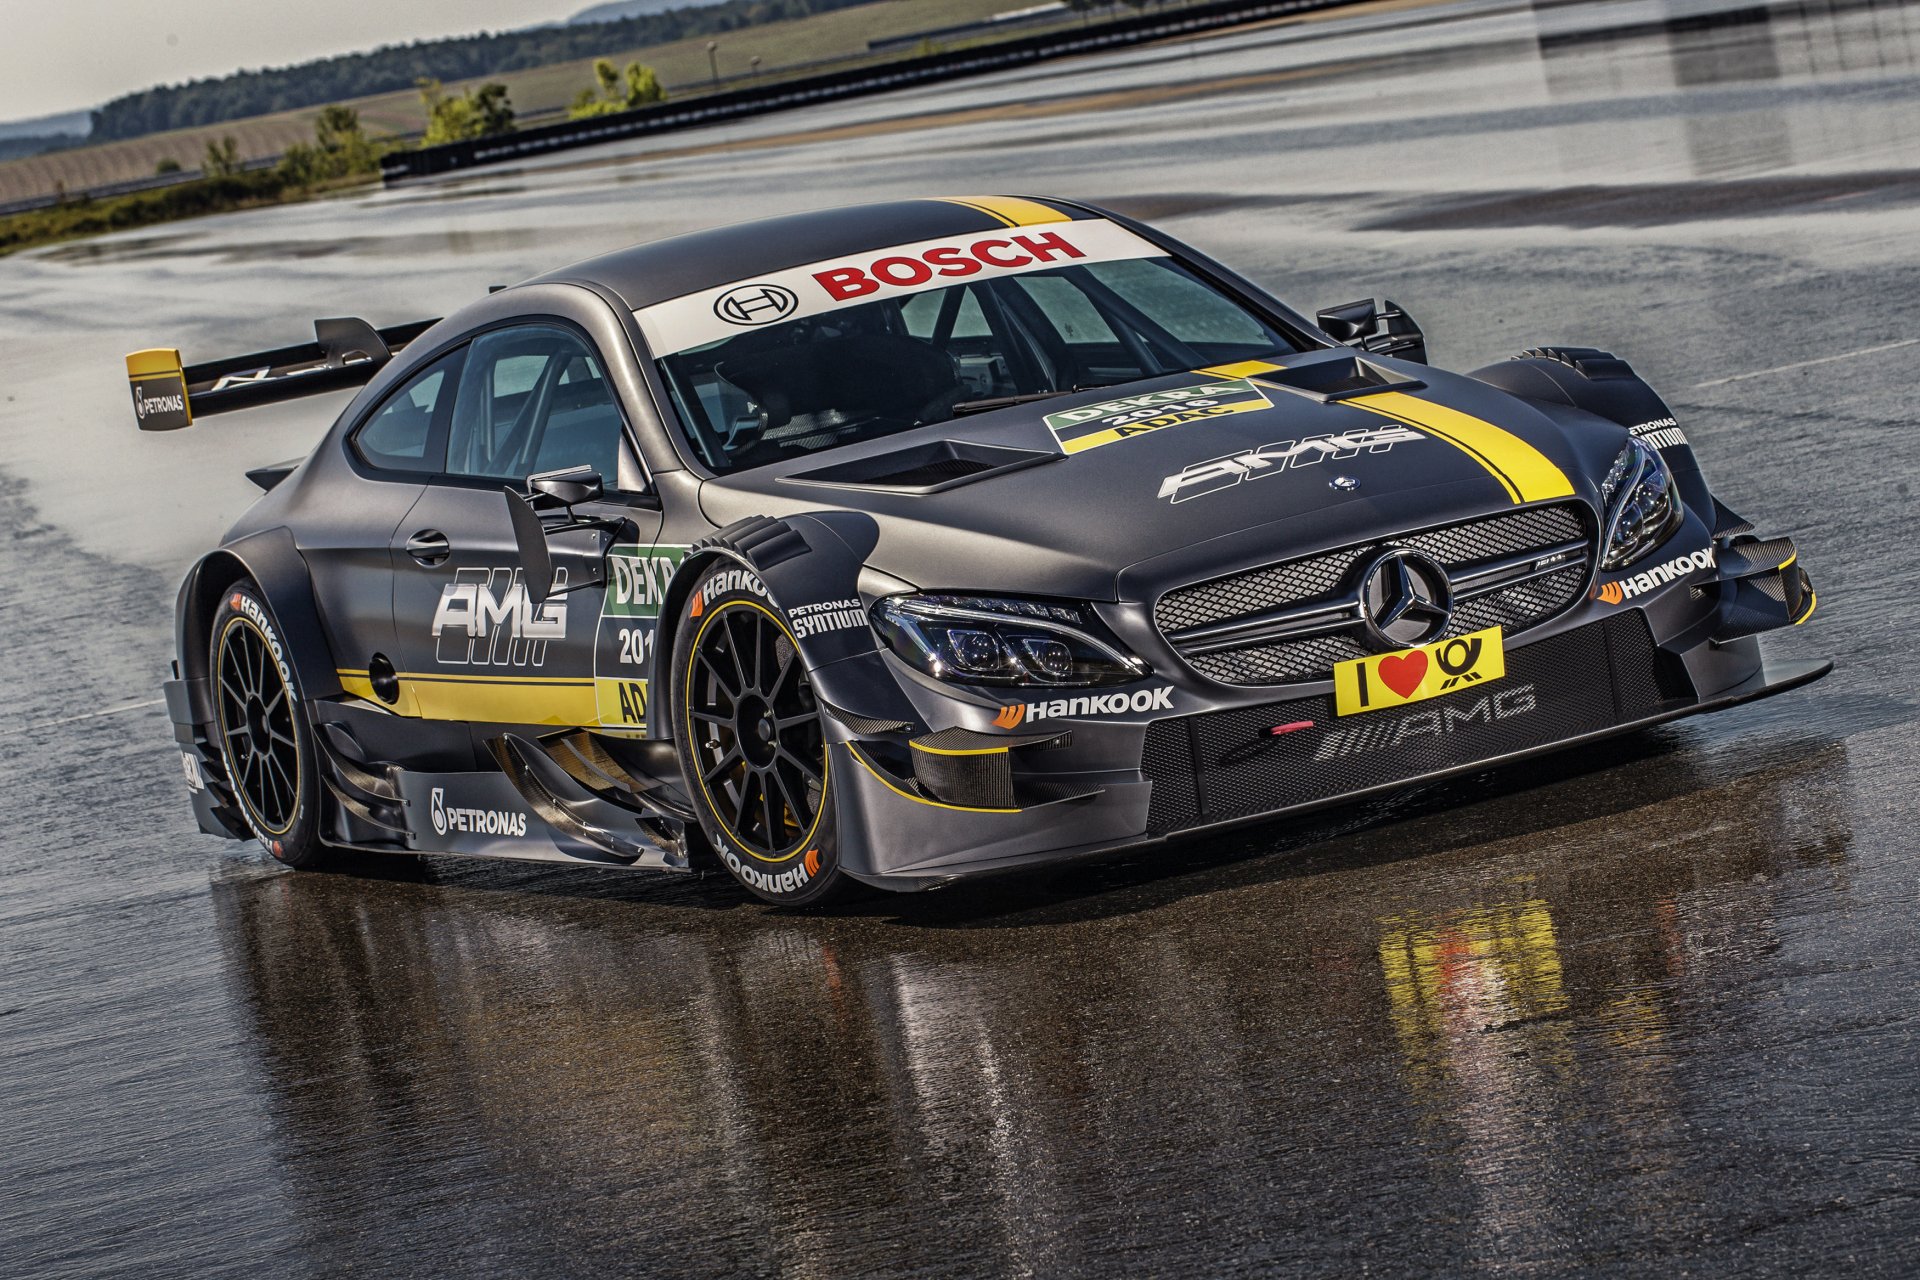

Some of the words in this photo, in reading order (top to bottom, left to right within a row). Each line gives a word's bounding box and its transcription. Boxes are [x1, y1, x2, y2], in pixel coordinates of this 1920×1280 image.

[811, 231, 1086, 302] BOSCH
[144, 395, 184, 415] PETRONAS
[1058, 385, 1242, 422] DEKRA
[1102, 399, 1219, 426] 2016
[1113, 406, 1234, 437] ADAC
[1629, 417, 1677, 435] ETRONAS
[1641, 427, 1689, 450] NTIUM
[1157, 427, 1427, 499] AMG
[611, 556, 685, 605] DEKR
[432, 582, 568, 640] AMG
[788, 598, 861, 618] PETRONAS
[792, 608, 869, 639] SYNTIUM
[618, 628, 654, 665] 201
[1356, 661, 1370, 707] I
[618, 681, 648, 724] AD
[446, 807, 527, 837] PETRONAS
